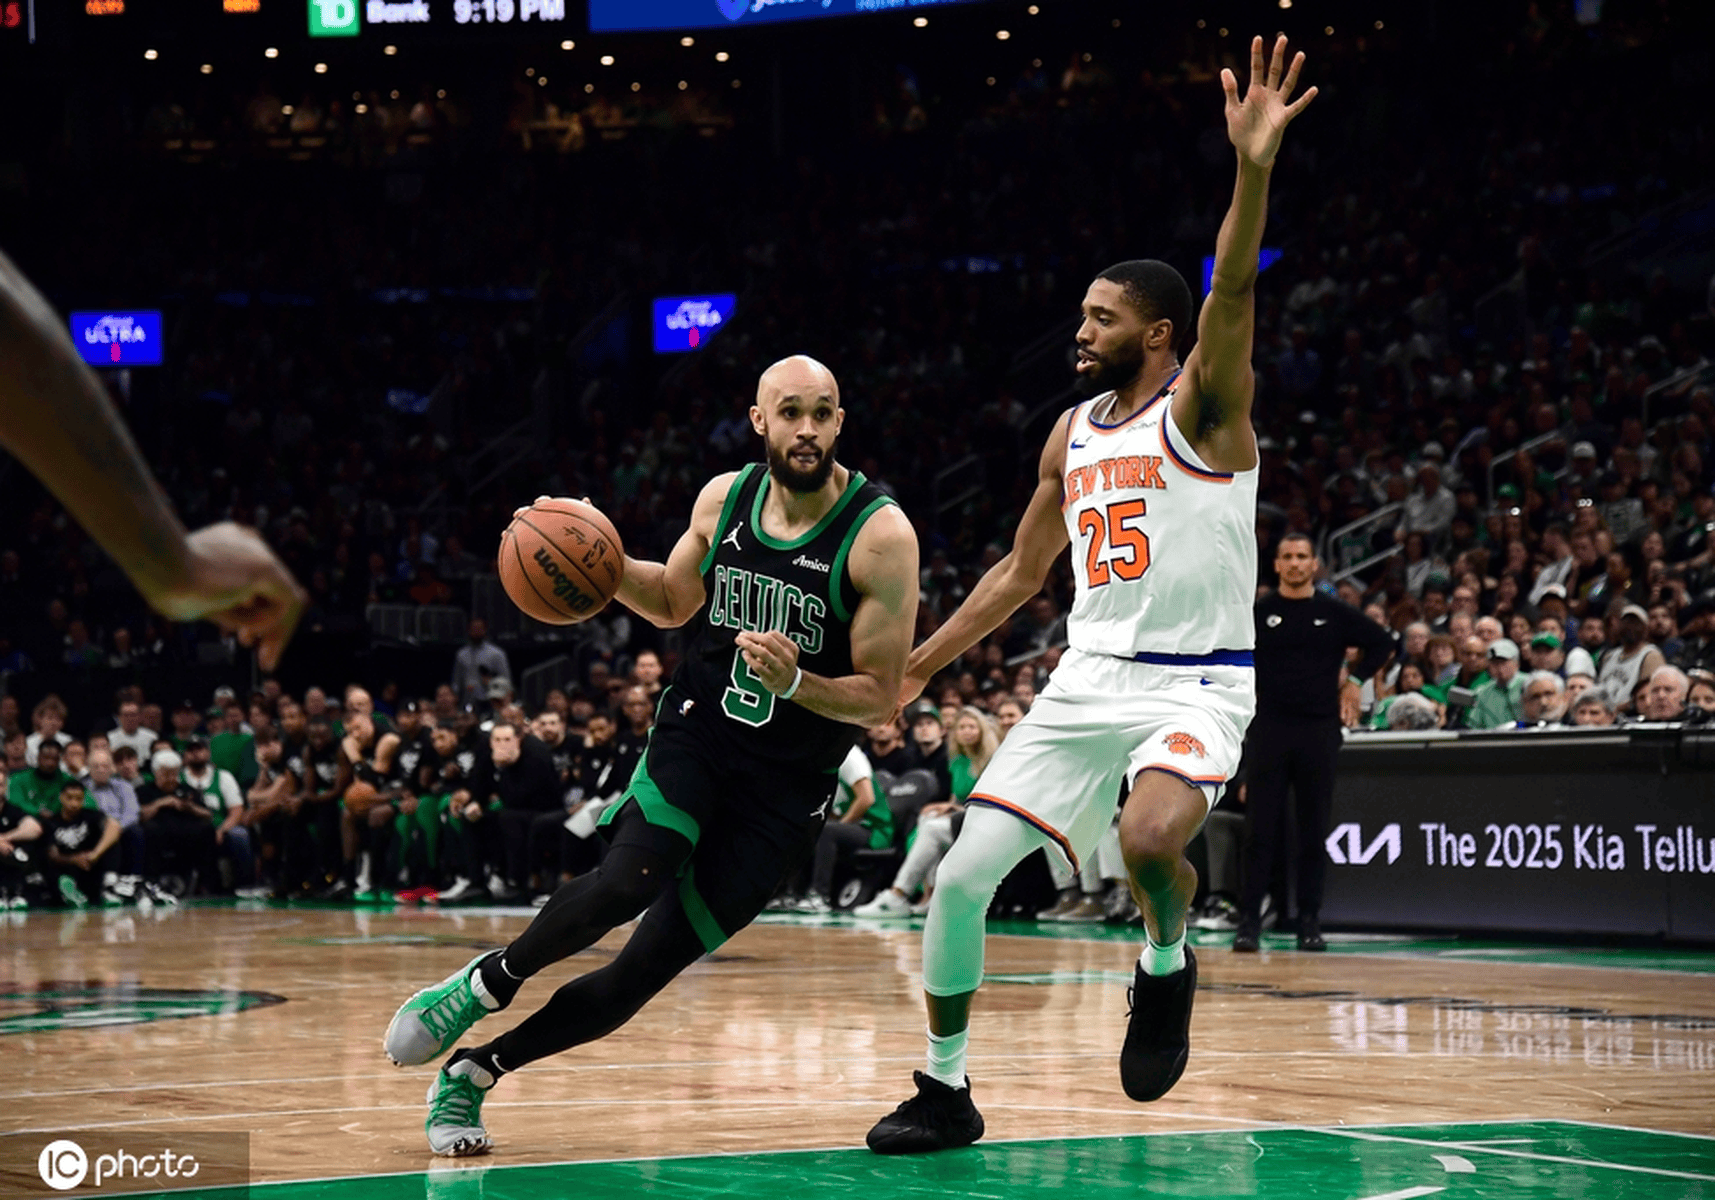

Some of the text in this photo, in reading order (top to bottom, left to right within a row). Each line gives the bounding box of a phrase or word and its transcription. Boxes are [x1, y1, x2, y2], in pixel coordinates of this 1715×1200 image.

[366, 0, 430, 23] Bank
[454, 0, 565, 23] 9:19 PM
[1065, 455, 1167, 505] EW YORK
[792, 555, 830, 573] Amica
[1078, 498, 1151, 589] 25
[709, 564, 826, 655] CELTICS
[1419, 823, 1477, 868] The
[1485, 824, 1564, 869] 2025
[1573, 824, 1625, 870] Kia
[1634, 825, 1715, 873] Tellu
